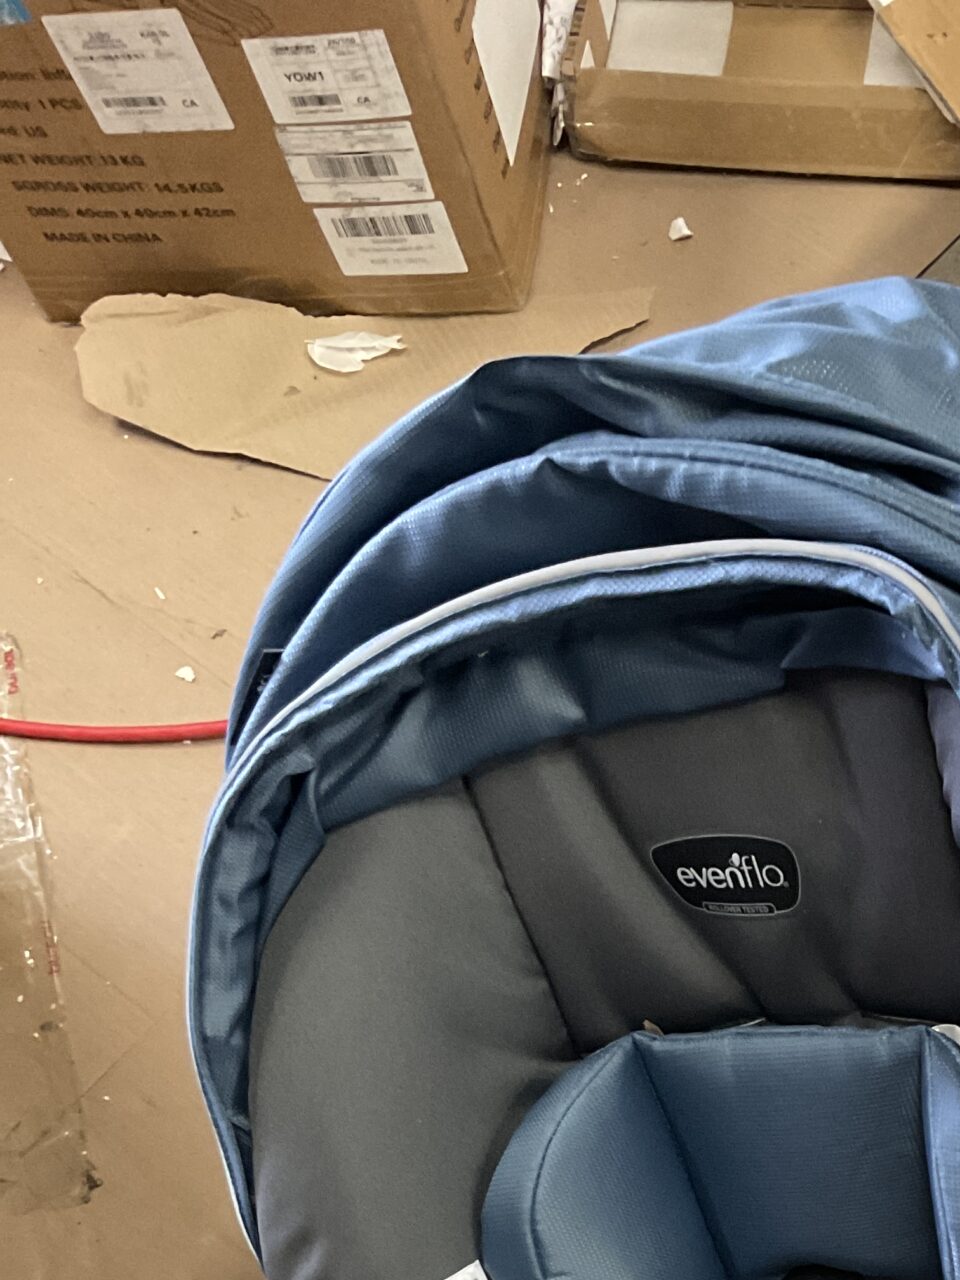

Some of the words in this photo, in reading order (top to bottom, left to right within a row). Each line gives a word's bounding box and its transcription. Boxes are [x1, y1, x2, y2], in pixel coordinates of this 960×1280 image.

[284, 72, 325, 82] YOW1
[43, 232, 88, 242] MADE
[92, 233, 110, 242] IN
[112, 233, 162, 242] CHINA
[676, 852, 784, 889] evenflo
